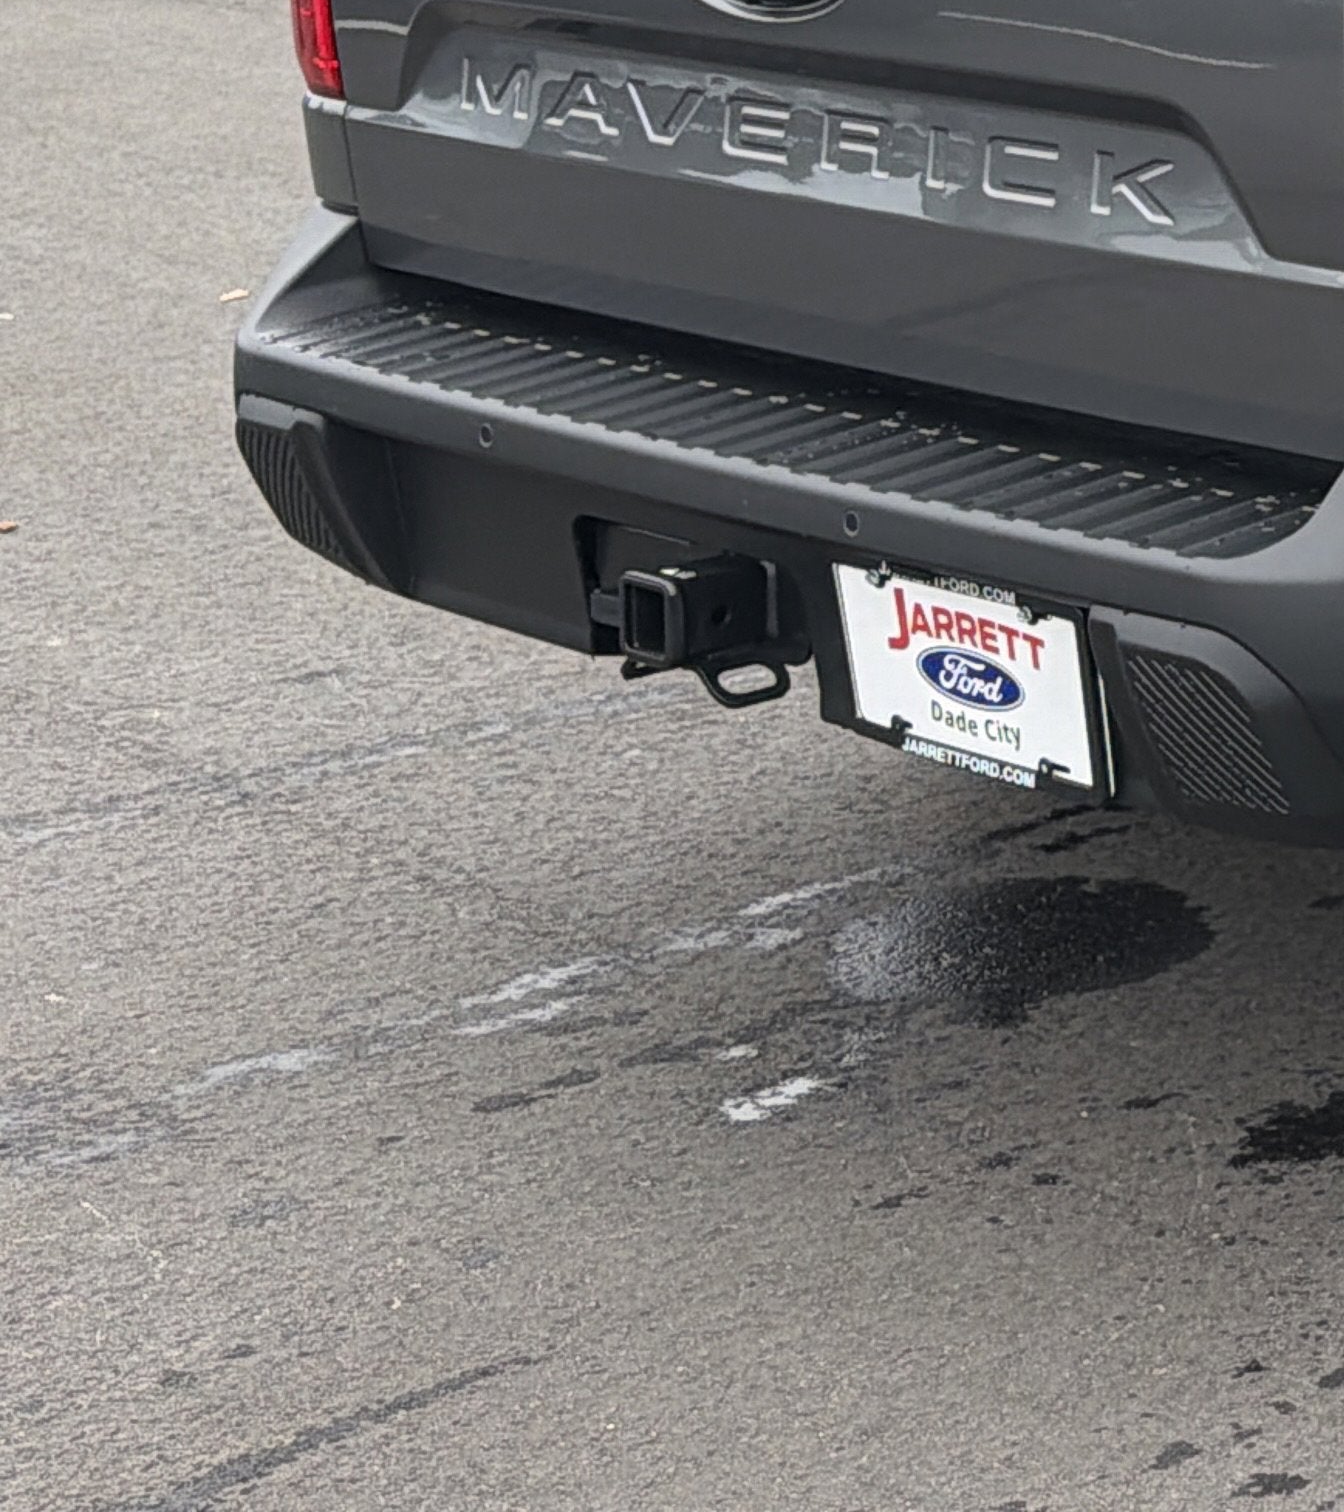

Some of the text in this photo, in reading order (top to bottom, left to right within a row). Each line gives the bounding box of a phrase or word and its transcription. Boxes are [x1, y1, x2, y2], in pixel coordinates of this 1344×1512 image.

[461, 48, 1175, 226] MAVERICK
[888, 587, 1045, 671] JARRETT
[938, 654, 1003, 703] Ford
[931, 699, 1021, 752] Dade City
[902, 737, 1036, 789] JARRETTFORD.COM
